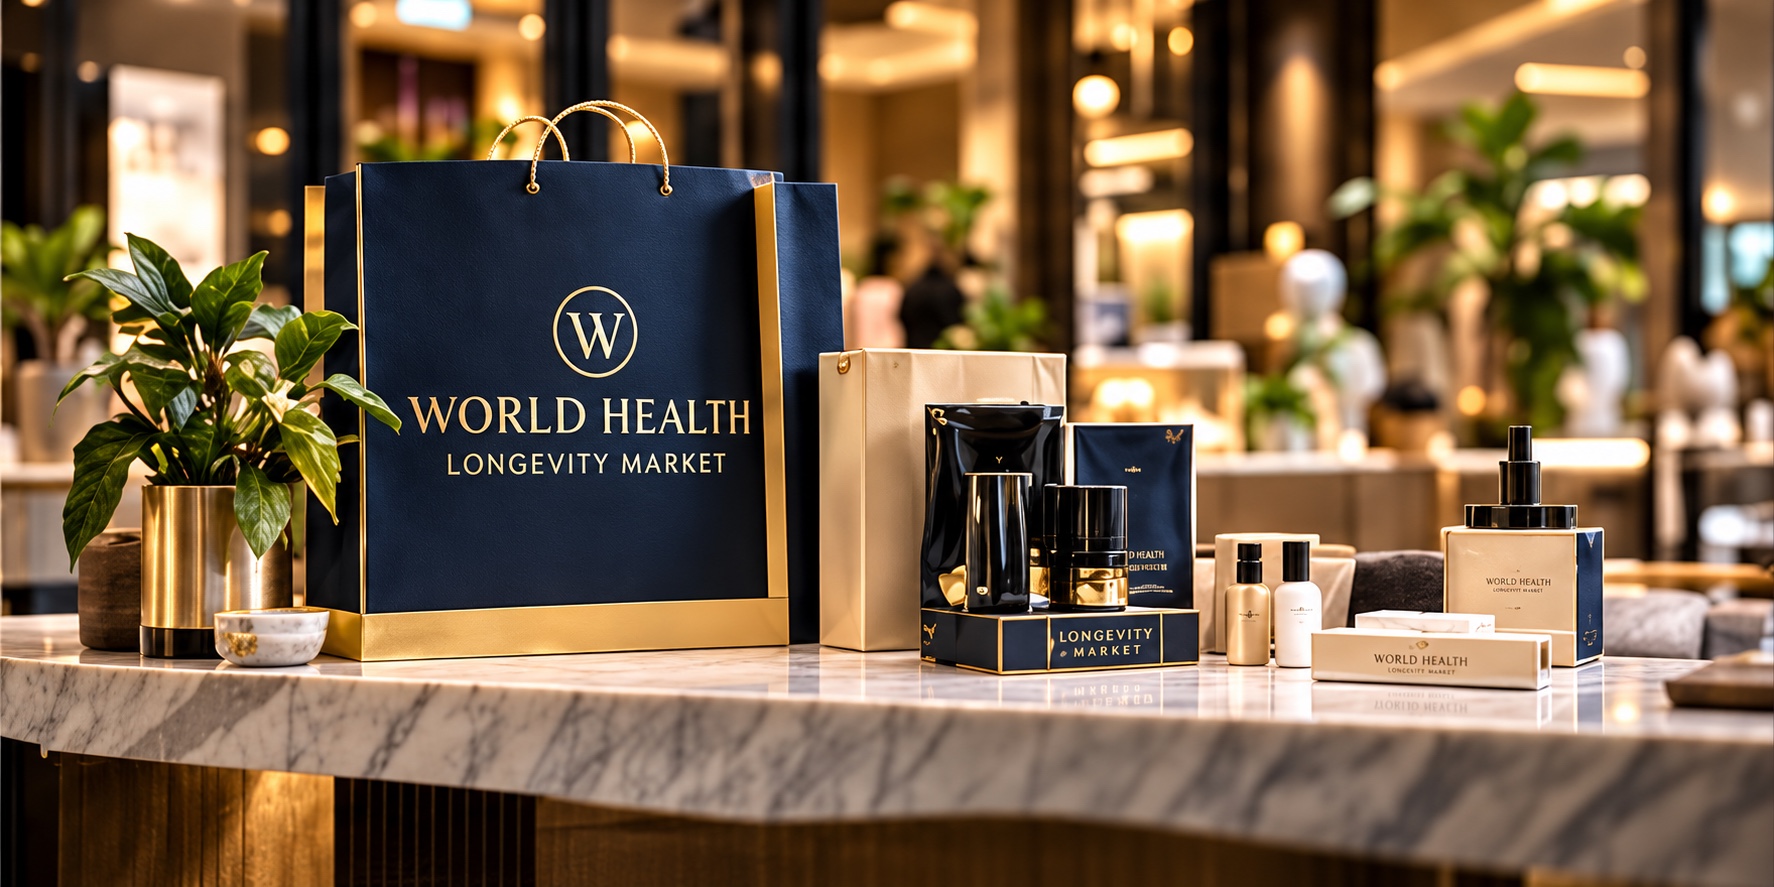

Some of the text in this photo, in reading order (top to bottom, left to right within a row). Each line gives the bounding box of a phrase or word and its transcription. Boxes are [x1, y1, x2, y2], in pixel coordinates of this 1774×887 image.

[566, 312, 625, 360] W
[407, 396, 751, 435] WORLD HEALTH
[447, 452, 726, 476] LONGEVITY MARKET
[1485, 577, 1551, 587] WORLD HEALTH
[1059, 627, 1153, 643] LONGEVITY
[1073, 644, 1141, 658] MARKET
[1373, 653, 1468, 667] WORLD HEALTH
